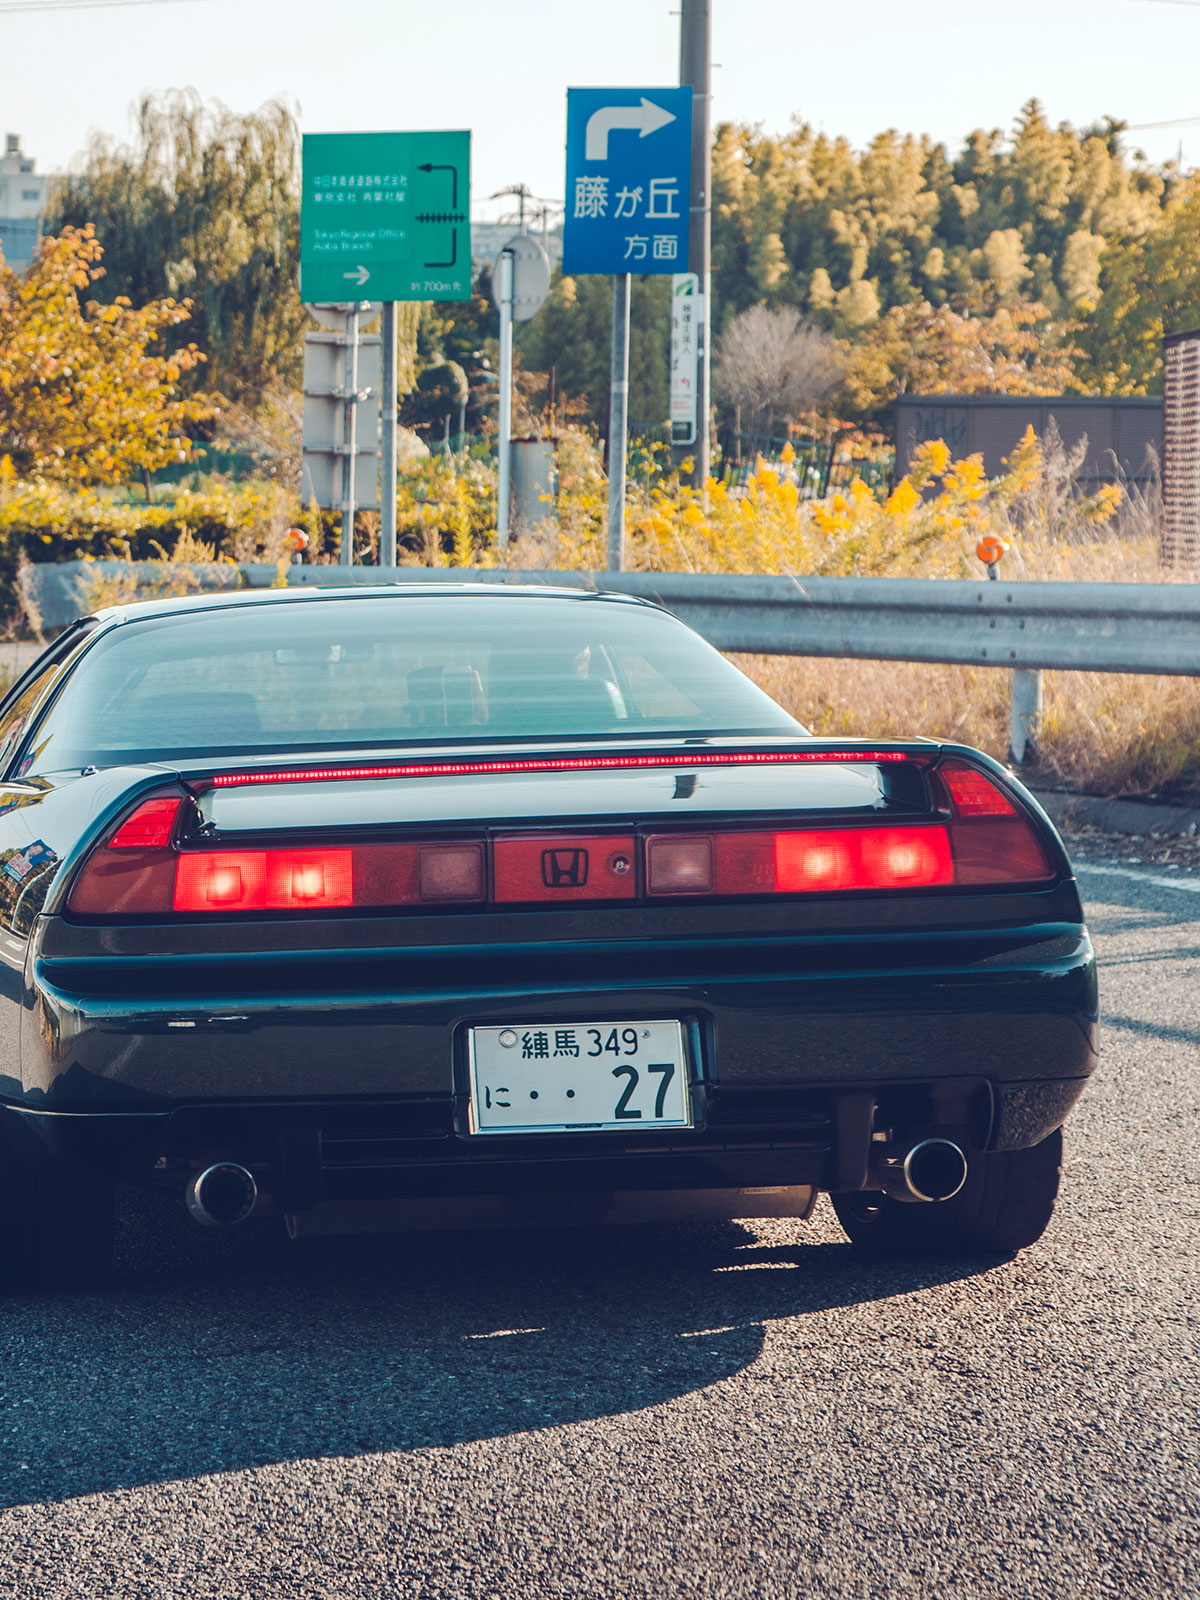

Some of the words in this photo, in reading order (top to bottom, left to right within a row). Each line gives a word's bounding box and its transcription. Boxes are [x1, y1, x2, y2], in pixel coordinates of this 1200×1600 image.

[574, 175, 680, 218] 藤が丘
[624, 234, 678, 259] 方面
[521, 1031, 580, 1059] 練馬
[586, 1028, 639, 1057] 349
